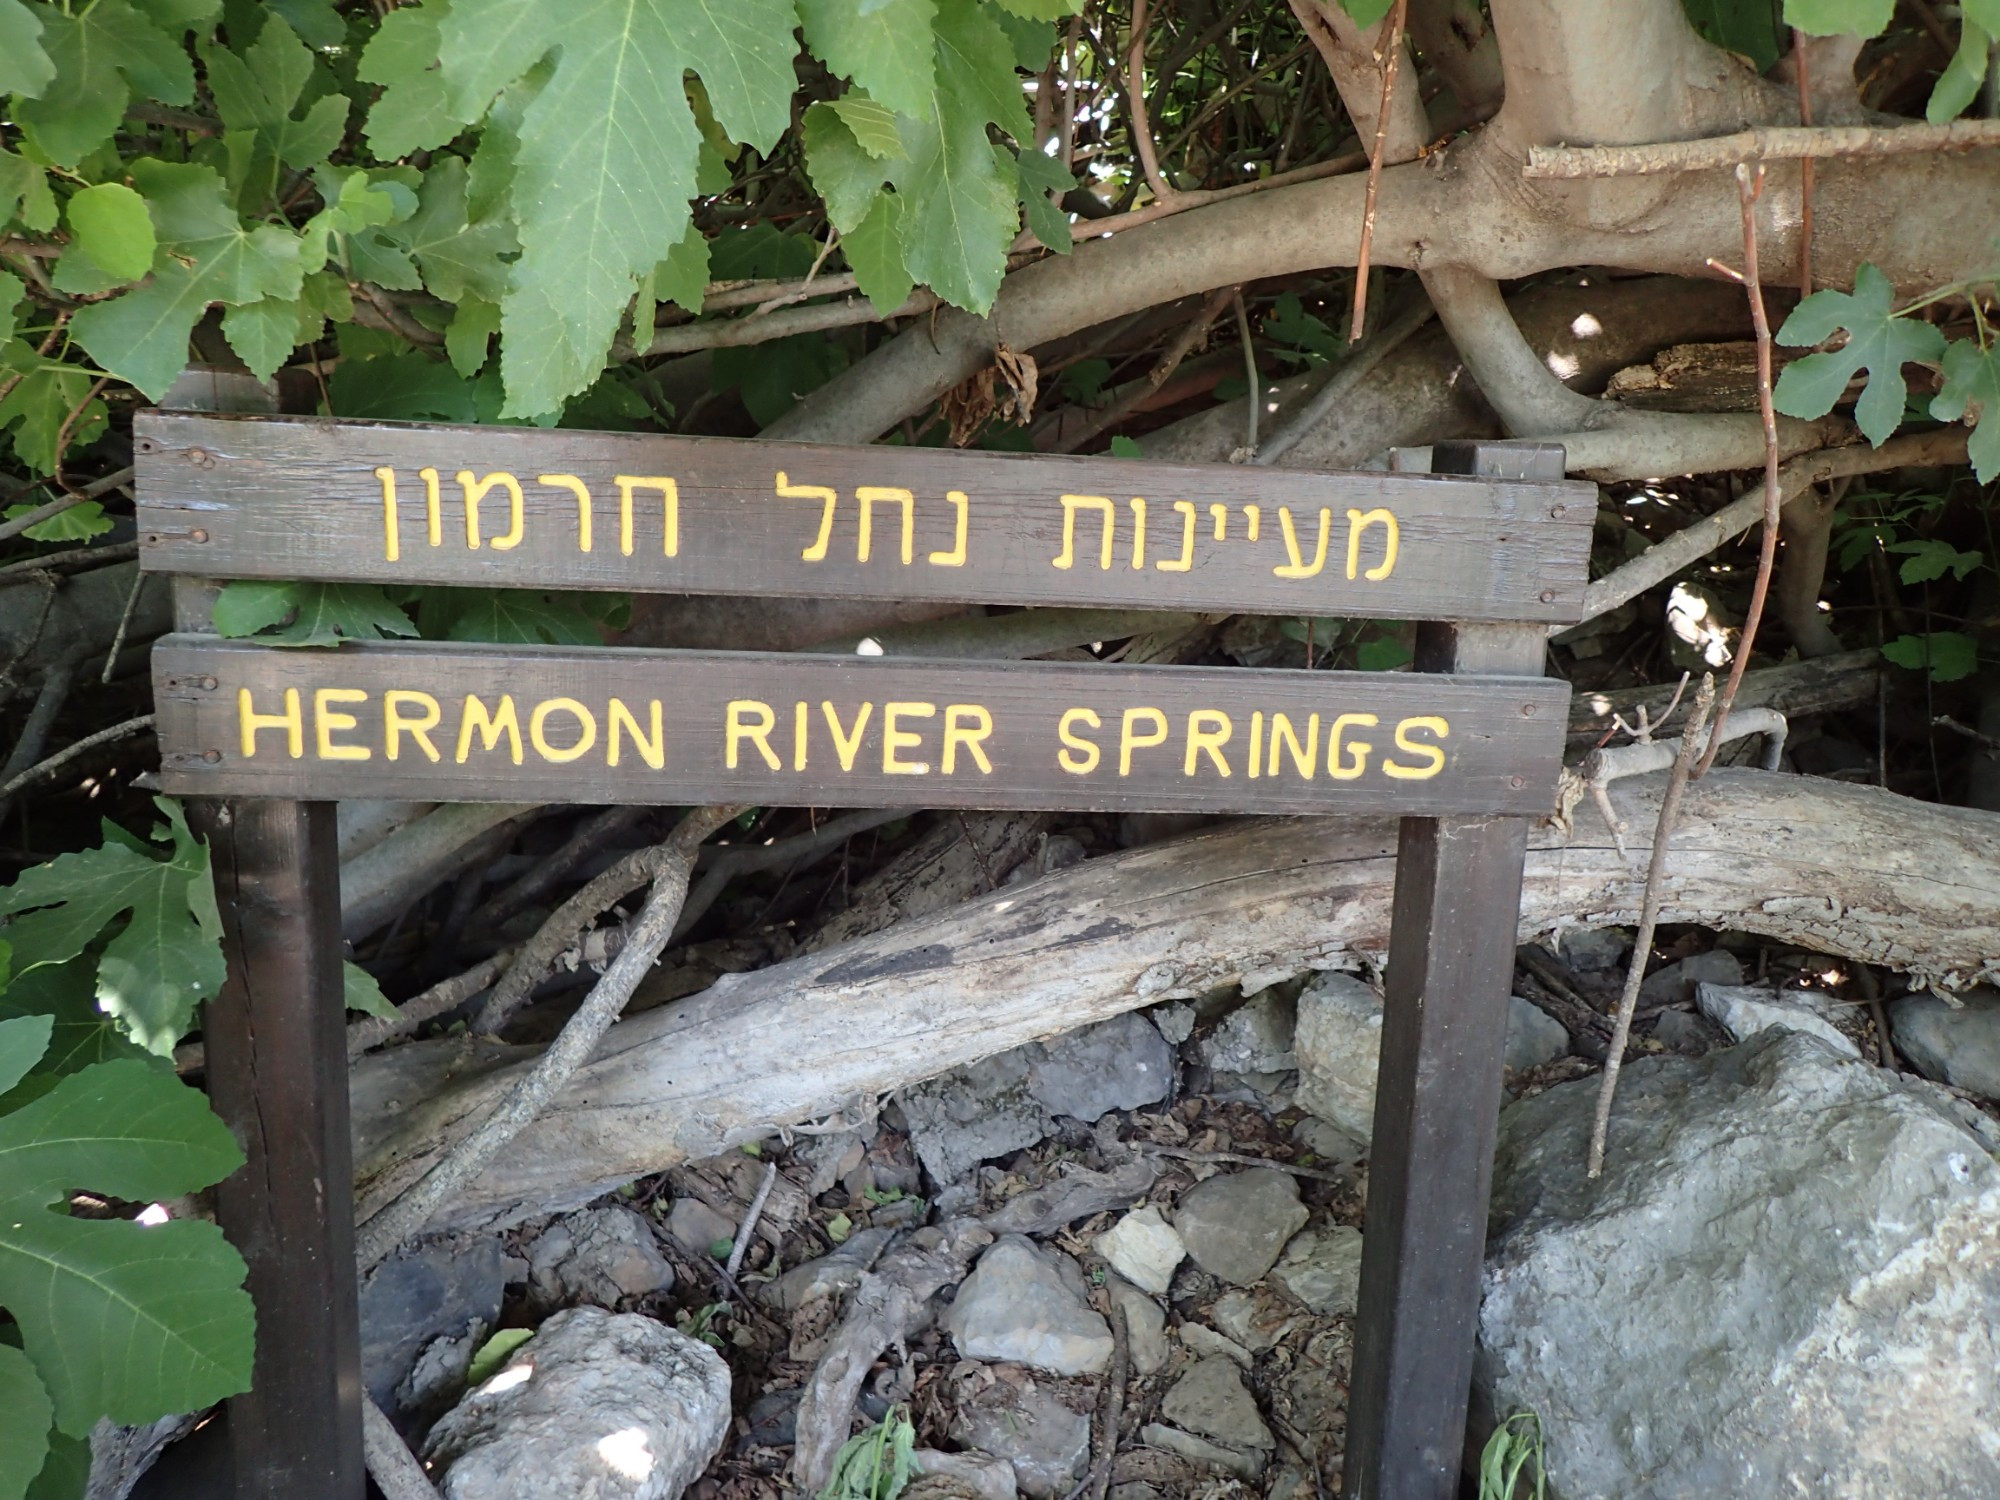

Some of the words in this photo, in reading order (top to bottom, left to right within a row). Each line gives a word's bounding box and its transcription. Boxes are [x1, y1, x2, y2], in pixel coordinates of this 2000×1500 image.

[375, 466, 679, 562] חרמון
[776, 471, 968, 568] נחל
[1052, 493, 1400, 581] מעיינות
[238, 687, 665, 769] HERMON
[726, 700, 994, 775] RIVER
[1057, 706, 1449, 780] SPRINGS
